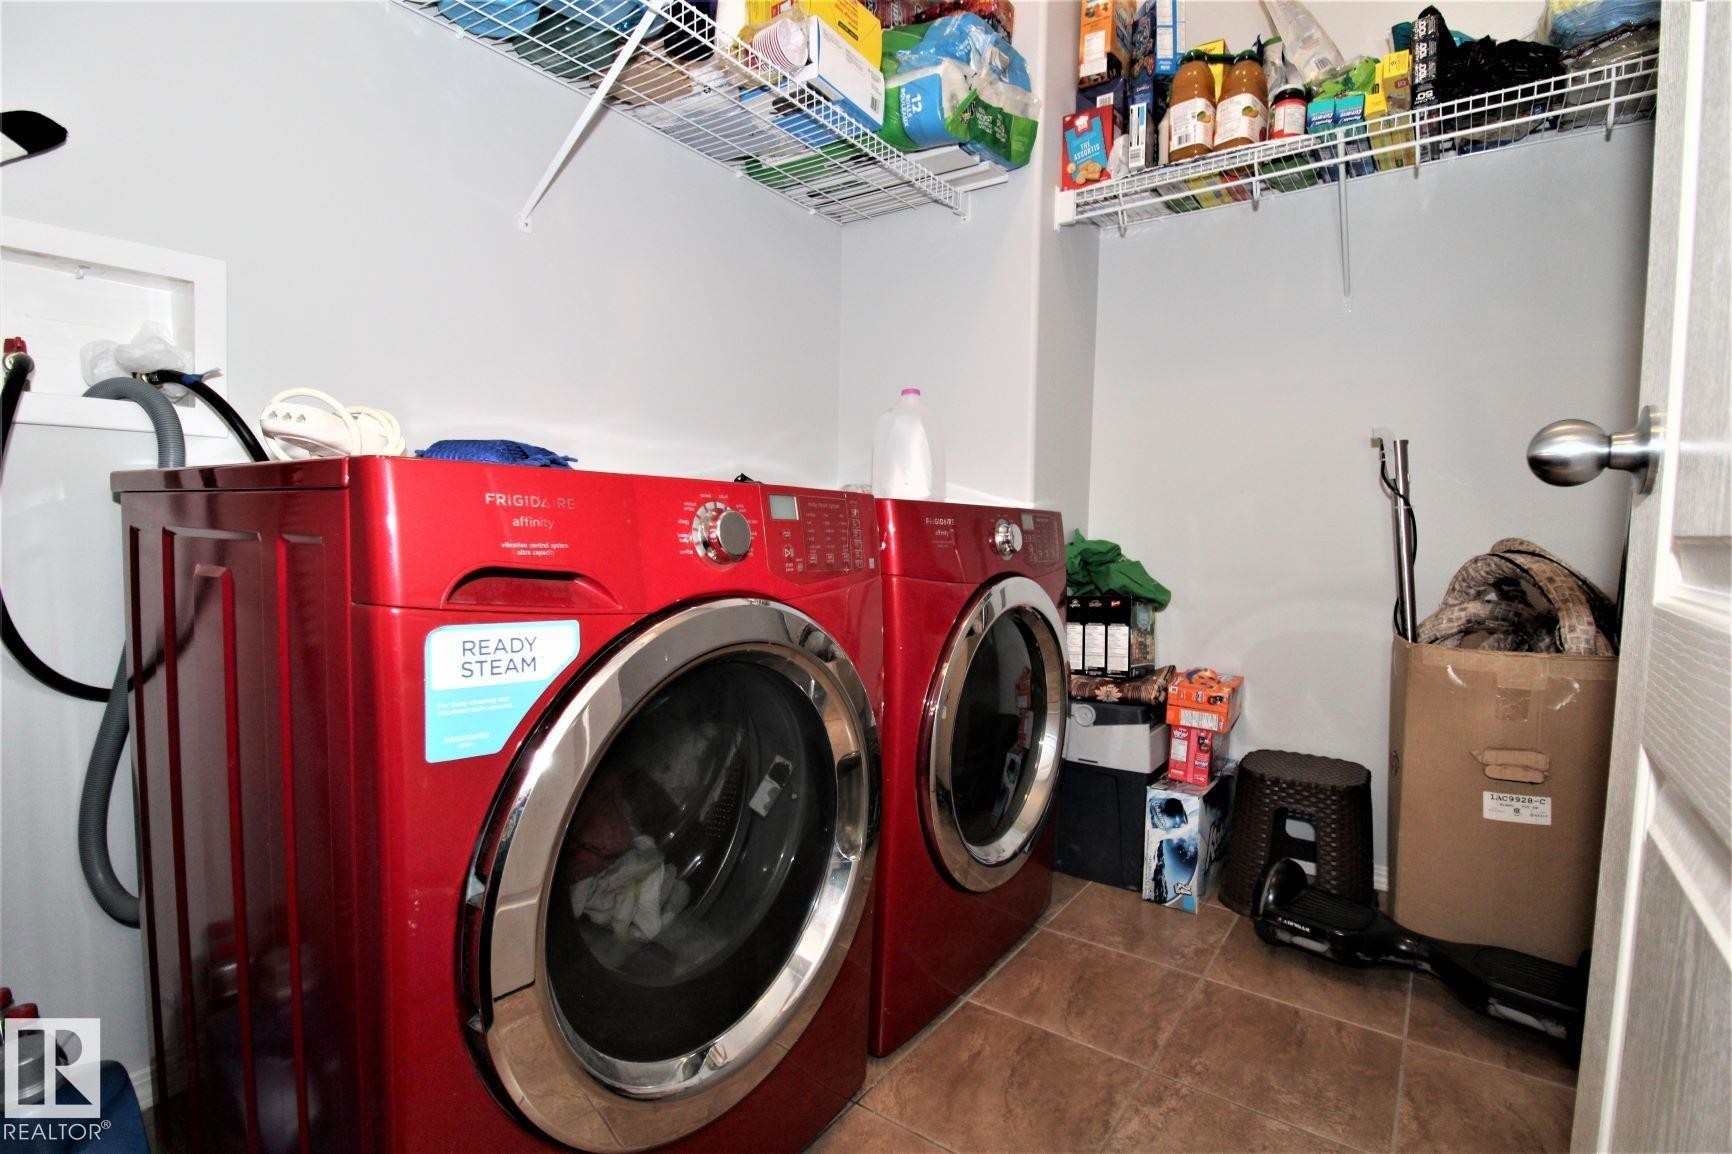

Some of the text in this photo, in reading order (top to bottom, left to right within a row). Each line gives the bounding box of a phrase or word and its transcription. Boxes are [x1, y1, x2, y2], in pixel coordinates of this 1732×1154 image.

[911, 93, 923, 113] 12
[512, 515, 554, 531] affinity
[461, 636, 538, 657] READY
[460, 656, 538, 678] STEAM
